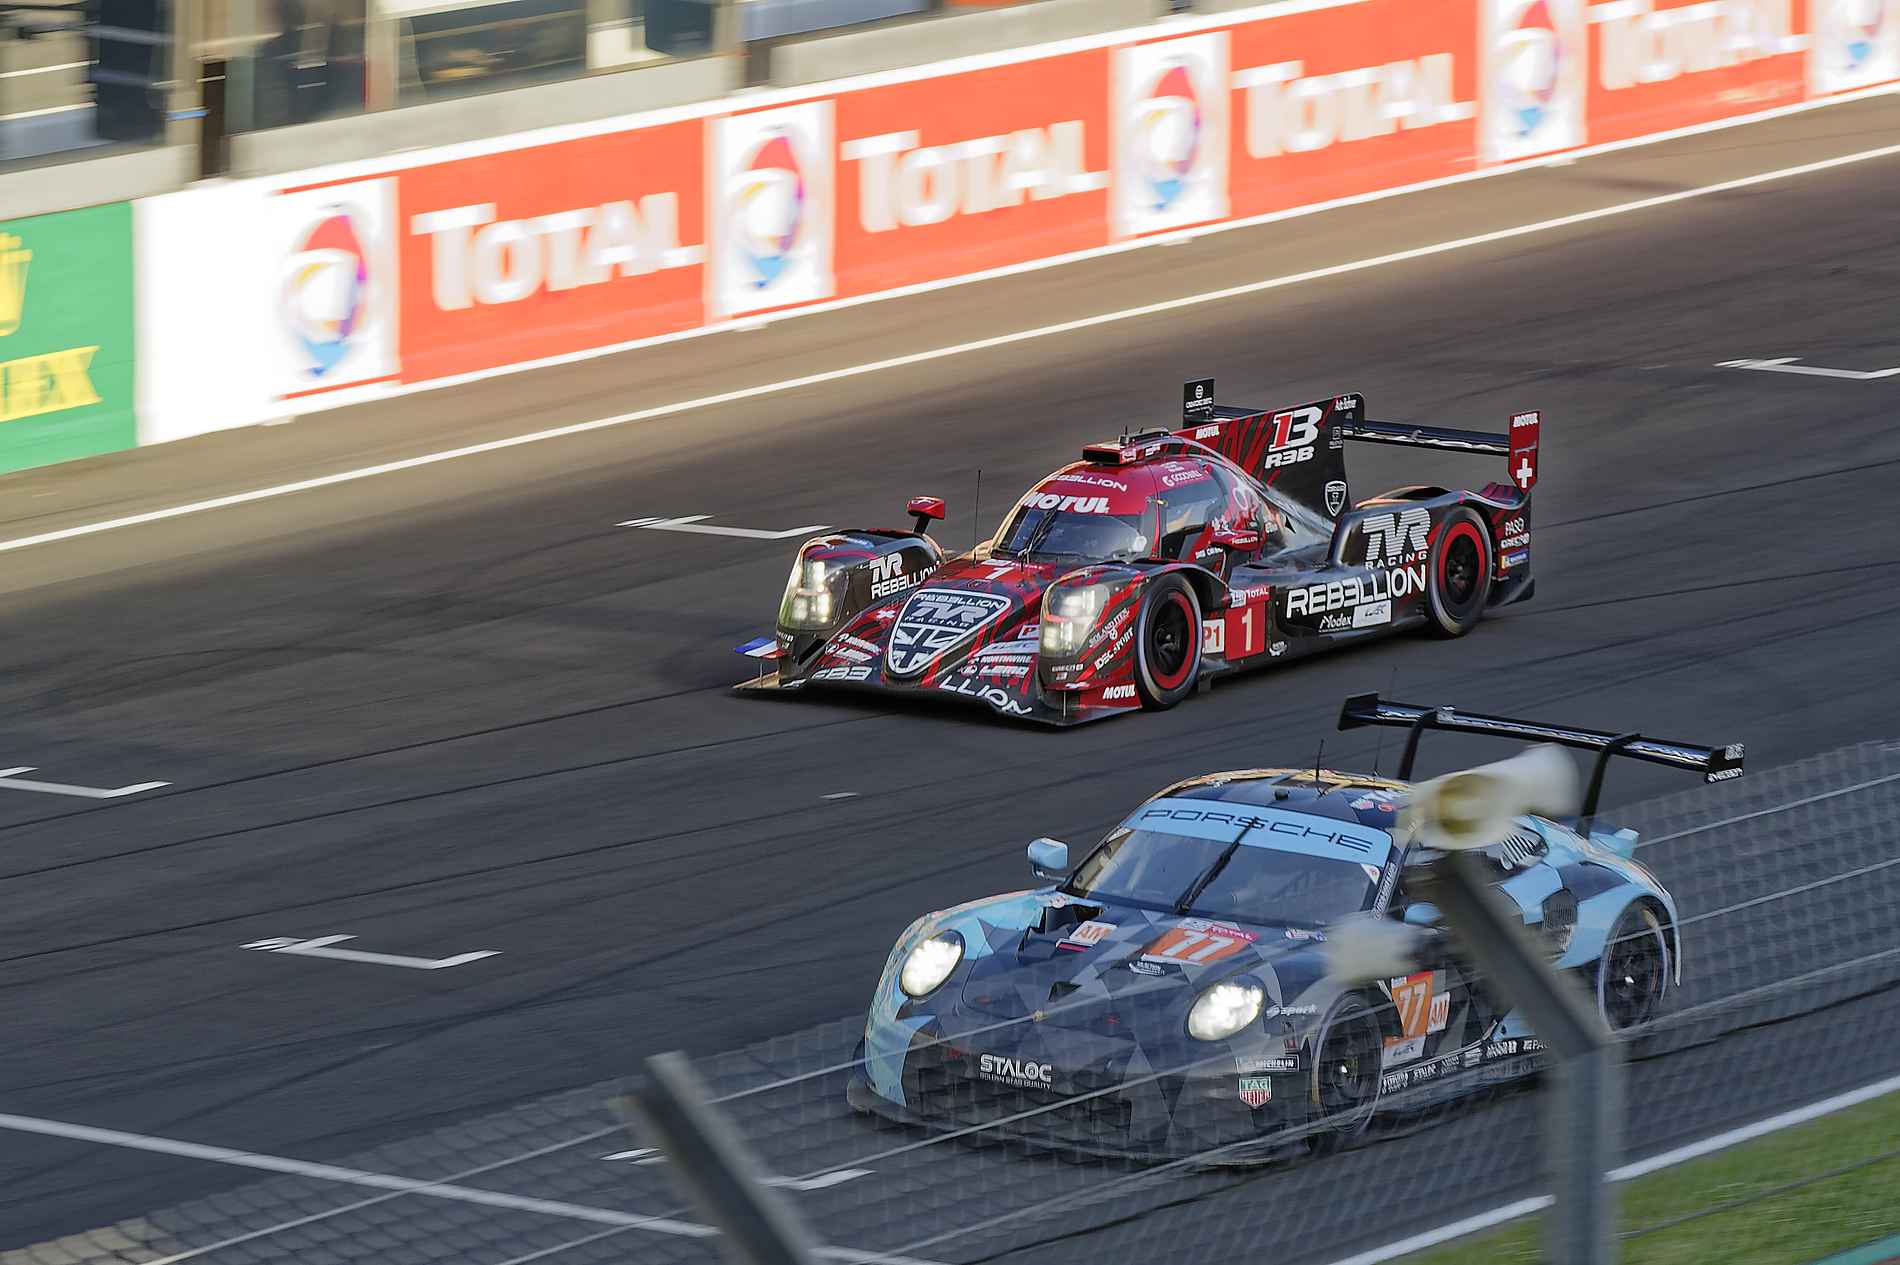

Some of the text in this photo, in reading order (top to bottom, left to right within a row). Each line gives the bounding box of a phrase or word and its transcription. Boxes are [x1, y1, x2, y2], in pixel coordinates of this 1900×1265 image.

[1231, 53, 1474, 159] TOTAL
[840, 120, 1110, 233] TOTAL
[411, 192, 702, 311] TOTAL
[1195, 425, 1220, 440] MOTUL
[1023, 491, 1110, 514] MOTUL
[1362, 507, 1431, 561] TVR
[869, 552, 903, 583] TVR
[1365, 550, 1428, 571] RACING
[914, 593, 1005, 610] REBELLION
[1246, 586, 1269, 599] TOTAL
[1286, 564, 1427, 619] REBELLION
[904, 616, 968, 628] RACING
[911, 602, 988, 624] TVR
[1241, 607, 1252, 652] 1
[1103, 683, 1136, 700] MOTUL
[1141, 808, 1374, 854] PORSCHE
[1160, 929, 1235, 961] 77
[1400, 982, 1426, 1036] 77
[980, 1054, 1052, 1083] STALOC
